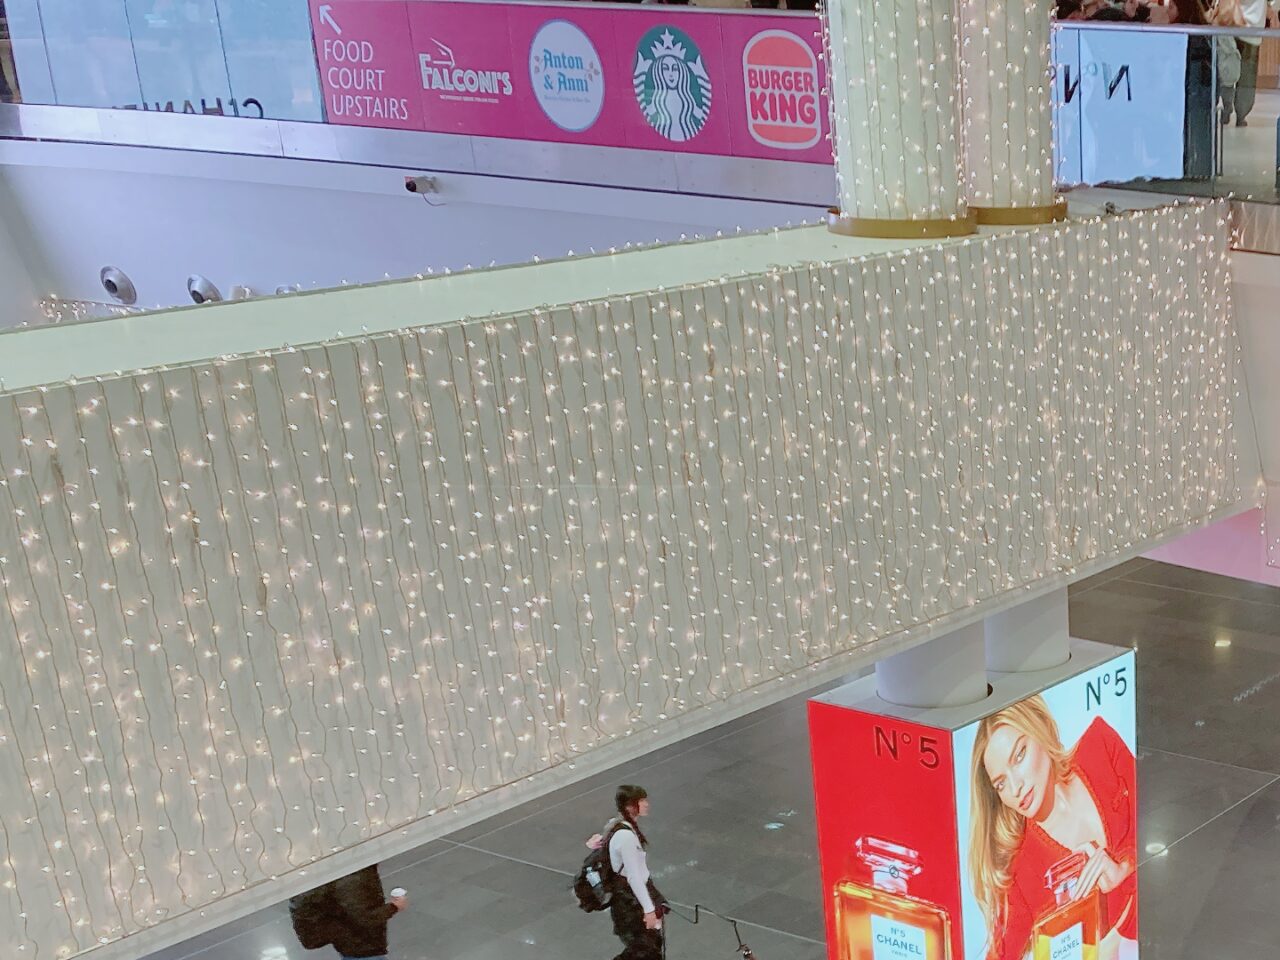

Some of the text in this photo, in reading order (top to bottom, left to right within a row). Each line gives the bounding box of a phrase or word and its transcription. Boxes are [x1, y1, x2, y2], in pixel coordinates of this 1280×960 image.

[323, 39, 374, 63] FOOD
[543, 48, 584, 71] Anton
[327, 66, 385, 91] COURT
[418, 52, 513, 96] FALCONI'S
[543, 71, 589, 95] & Anni
[748, 68, 815, 93] BURGER
[332, 94, 408, 120] UPSTAIRS
[749, 91, 817, 125] KING
[876, 934, 922, 956] CHANEL
[1052, 938, 1080, 960] CHANEL
